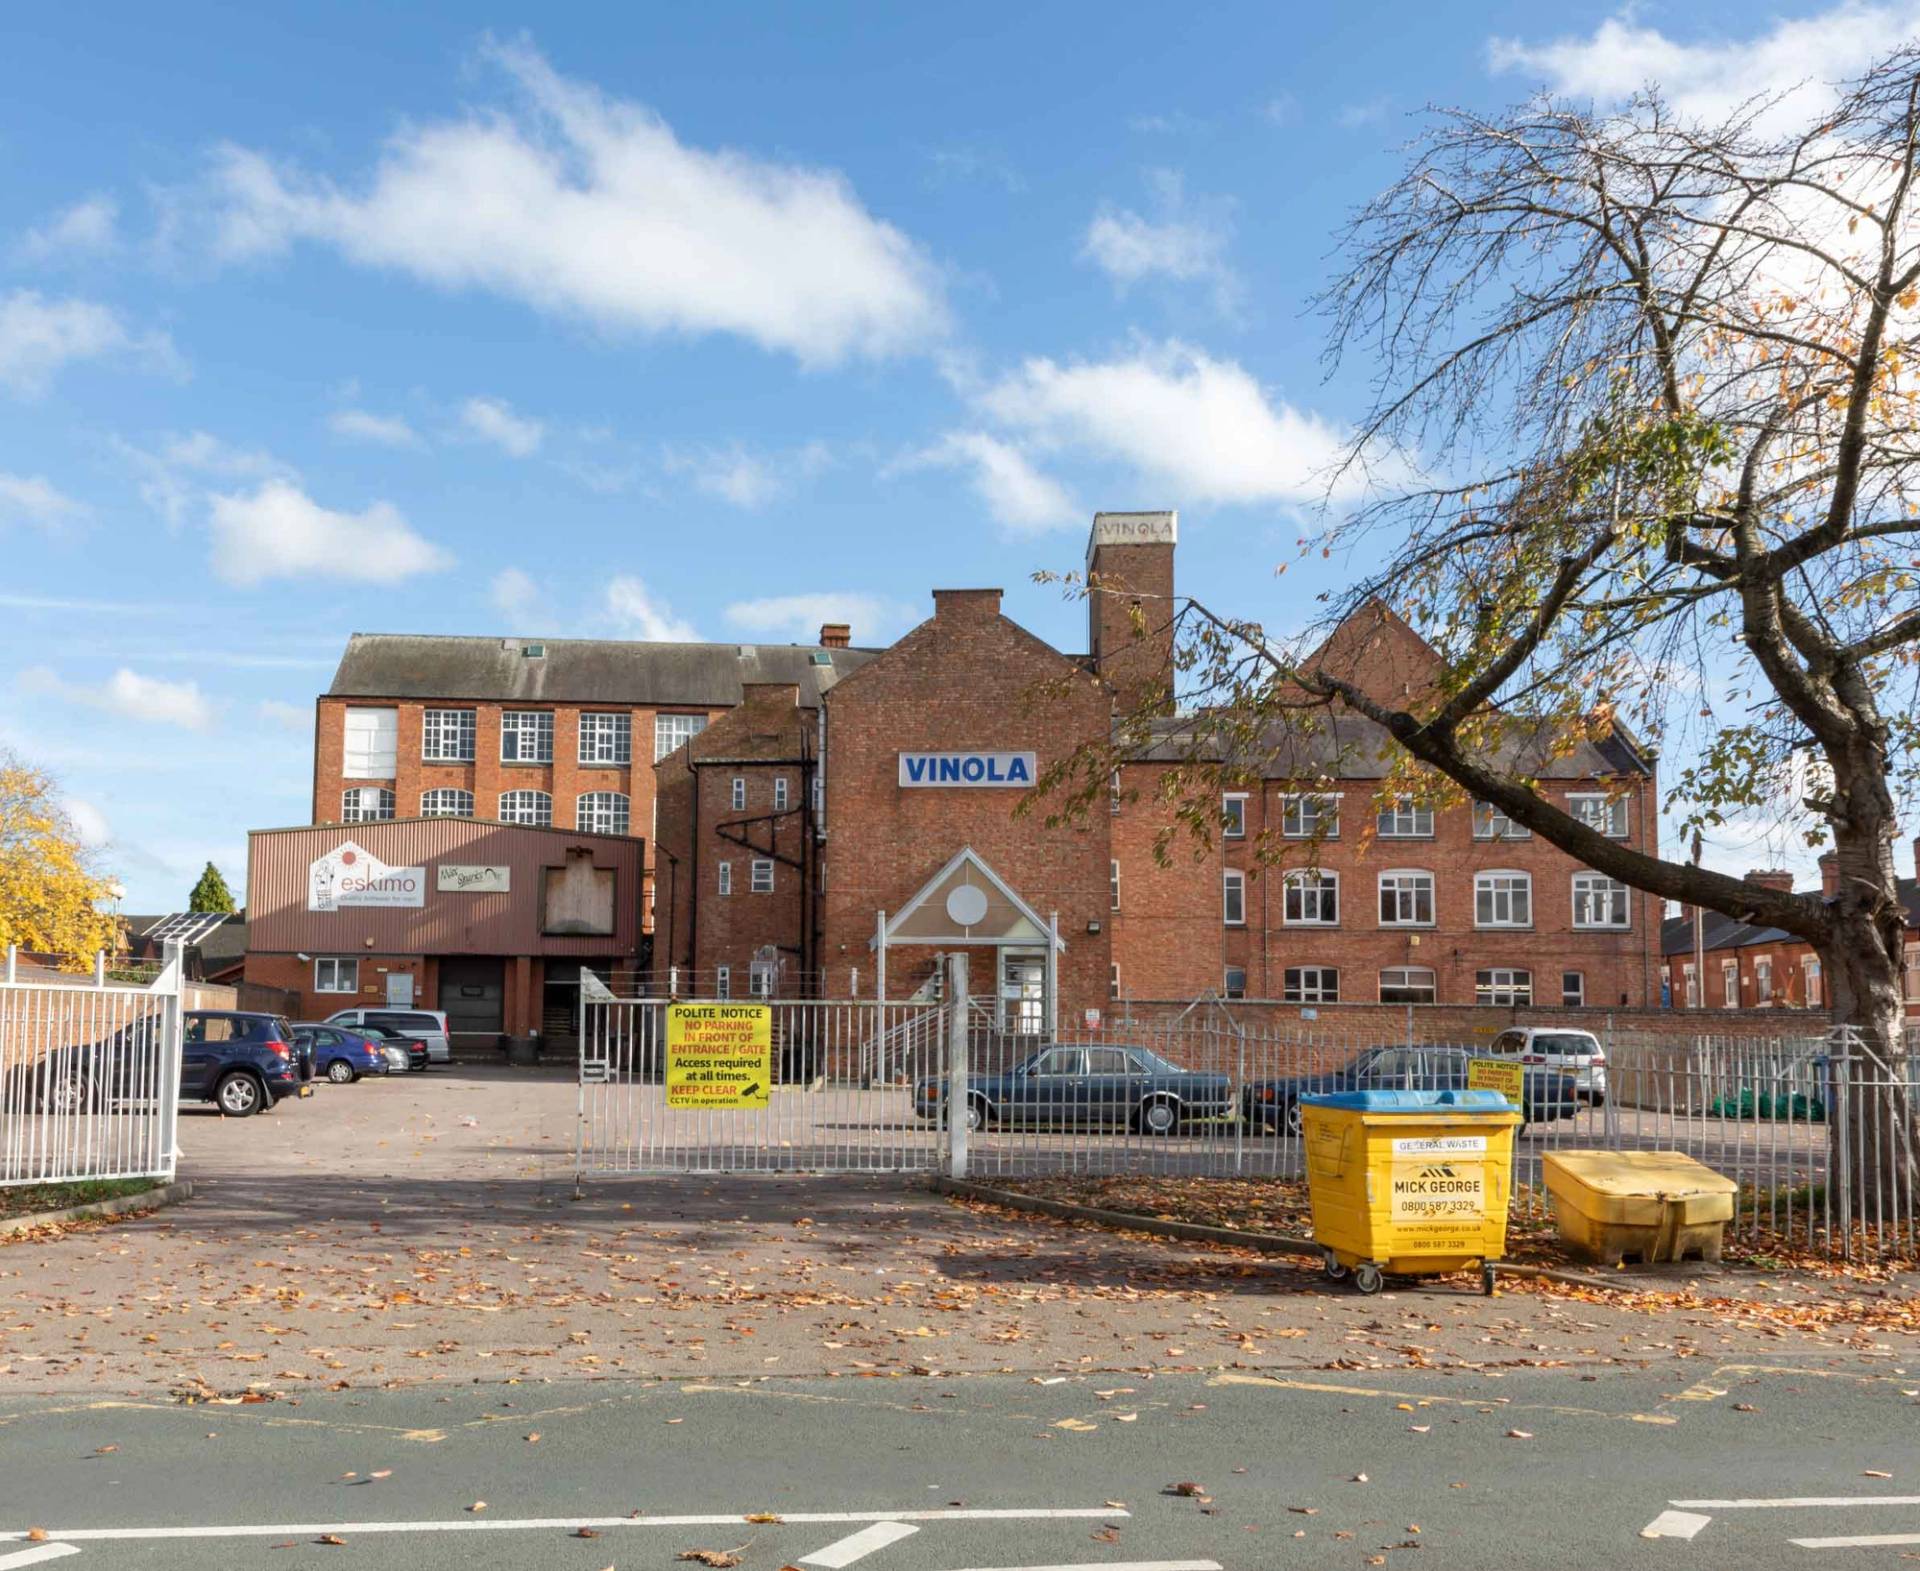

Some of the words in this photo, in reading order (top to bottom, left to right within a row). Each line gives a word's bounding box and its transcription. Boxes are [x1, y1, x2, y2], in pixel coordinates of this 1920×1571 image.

[1102, 522, 1173, 535] VINOLA
[905, 757, 1029, 782] VINOLA
[341, 863, 416, 892] eskimo
[675, 1008, 715, 1018] POLITE
[721, 1008, 763, 1018] NOTICE
[685, 1021, 701, 1030] NO
[704, 1021, 754, 1031] PARKING
[684, 1033, 696, 1042] IN
[699, 1033, 736, 1042] FRONT
[738, 1032, 754, 1042] OF
[671, 1044, 729, 1054] ENTRANCE
[739, 1045, 767, 1054] GATE
[675, 1058, 712, 1067] Access
[713, 1058, 762, 1070] required
[686, 1071, 698, 1081] at
[699, 1071, 714, 1081] all
[715, 1071, 751, 1081] times.
[671, 1085, 700, 1095] KEEP
[702, 1085, 737, 1096] CLEAR
[700, 1097, 739, 1105] operation
[1446, 1139, 1479, 1149] WASTE
[1395, 1181, 1427, 1193] MICK
[1430, 1181, 1481, 1193] GEORGE
[1401, 1201, 1426, 1212] 0800
[1429, 1202, 1448, 1212] 587
[1450, 1201, 1475, 1211] 3329
[1396, 1225, 1481, 1233] www.mickgeorge.co.uk
[1413, 1241, 1431, 1249] 0800
